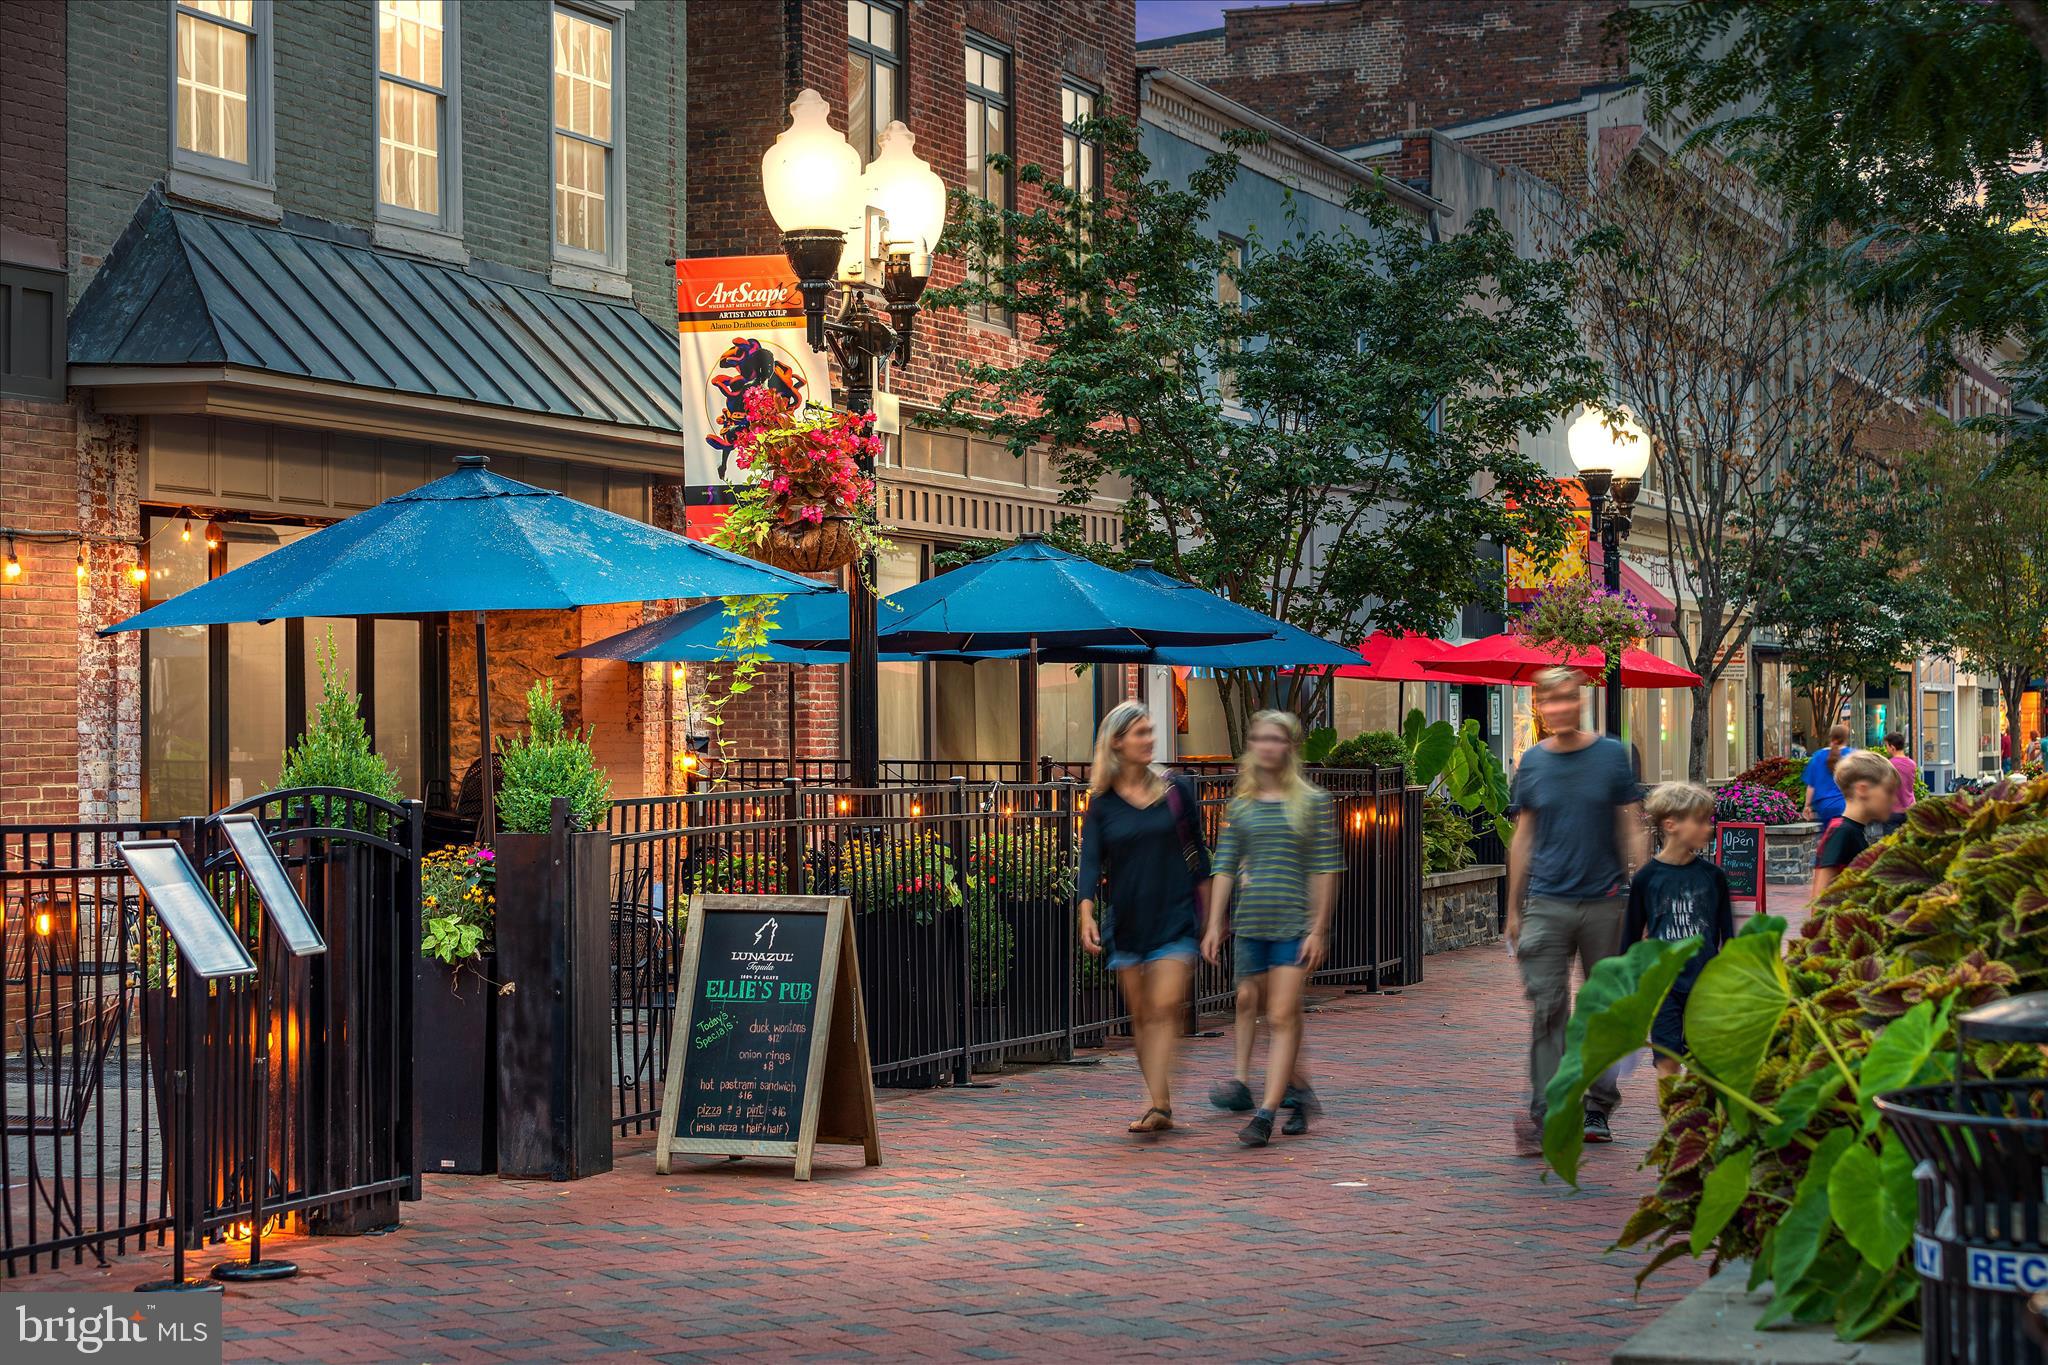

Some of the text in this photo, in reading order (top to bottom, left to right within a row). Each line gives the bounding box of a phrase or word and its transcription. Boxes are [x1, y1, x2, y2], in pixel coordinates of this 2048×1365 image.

[695, 281, 788, 308] ArtScape
[719, 309, 788, 319] ARTIST: ANDY KULP
[710, 319, 797, 330] Alamo Drafthouse Cinema
[1725, 831, 1754, 850] Open
[1671, 899, 1694, 913] RULE
[1673, 913, 1691, 926] THE
[1666, 924, 1701, 940] GALAXY
[746, 961, 775, 973] Tequila
[705, 980, 812, 1000] ELLIE'S PUB
[696, 1010, 729, 1032] Today's
[749, 1018, 807, 1033] duck wontons
[767, 1034, 780, 1043] $12
[739, 1049, 791, 1065] onion rings
[762, 1061, 774, 1071] $8
[700, 1077, 797, 1093] hot pastrami sandwich
[696, 1103, 722, 1118] pizza
[746, 1103, 765, 1118] pint
[718, 1122, 738, 1133] pizza
[1973, 1253, 2048, 1289] REC
